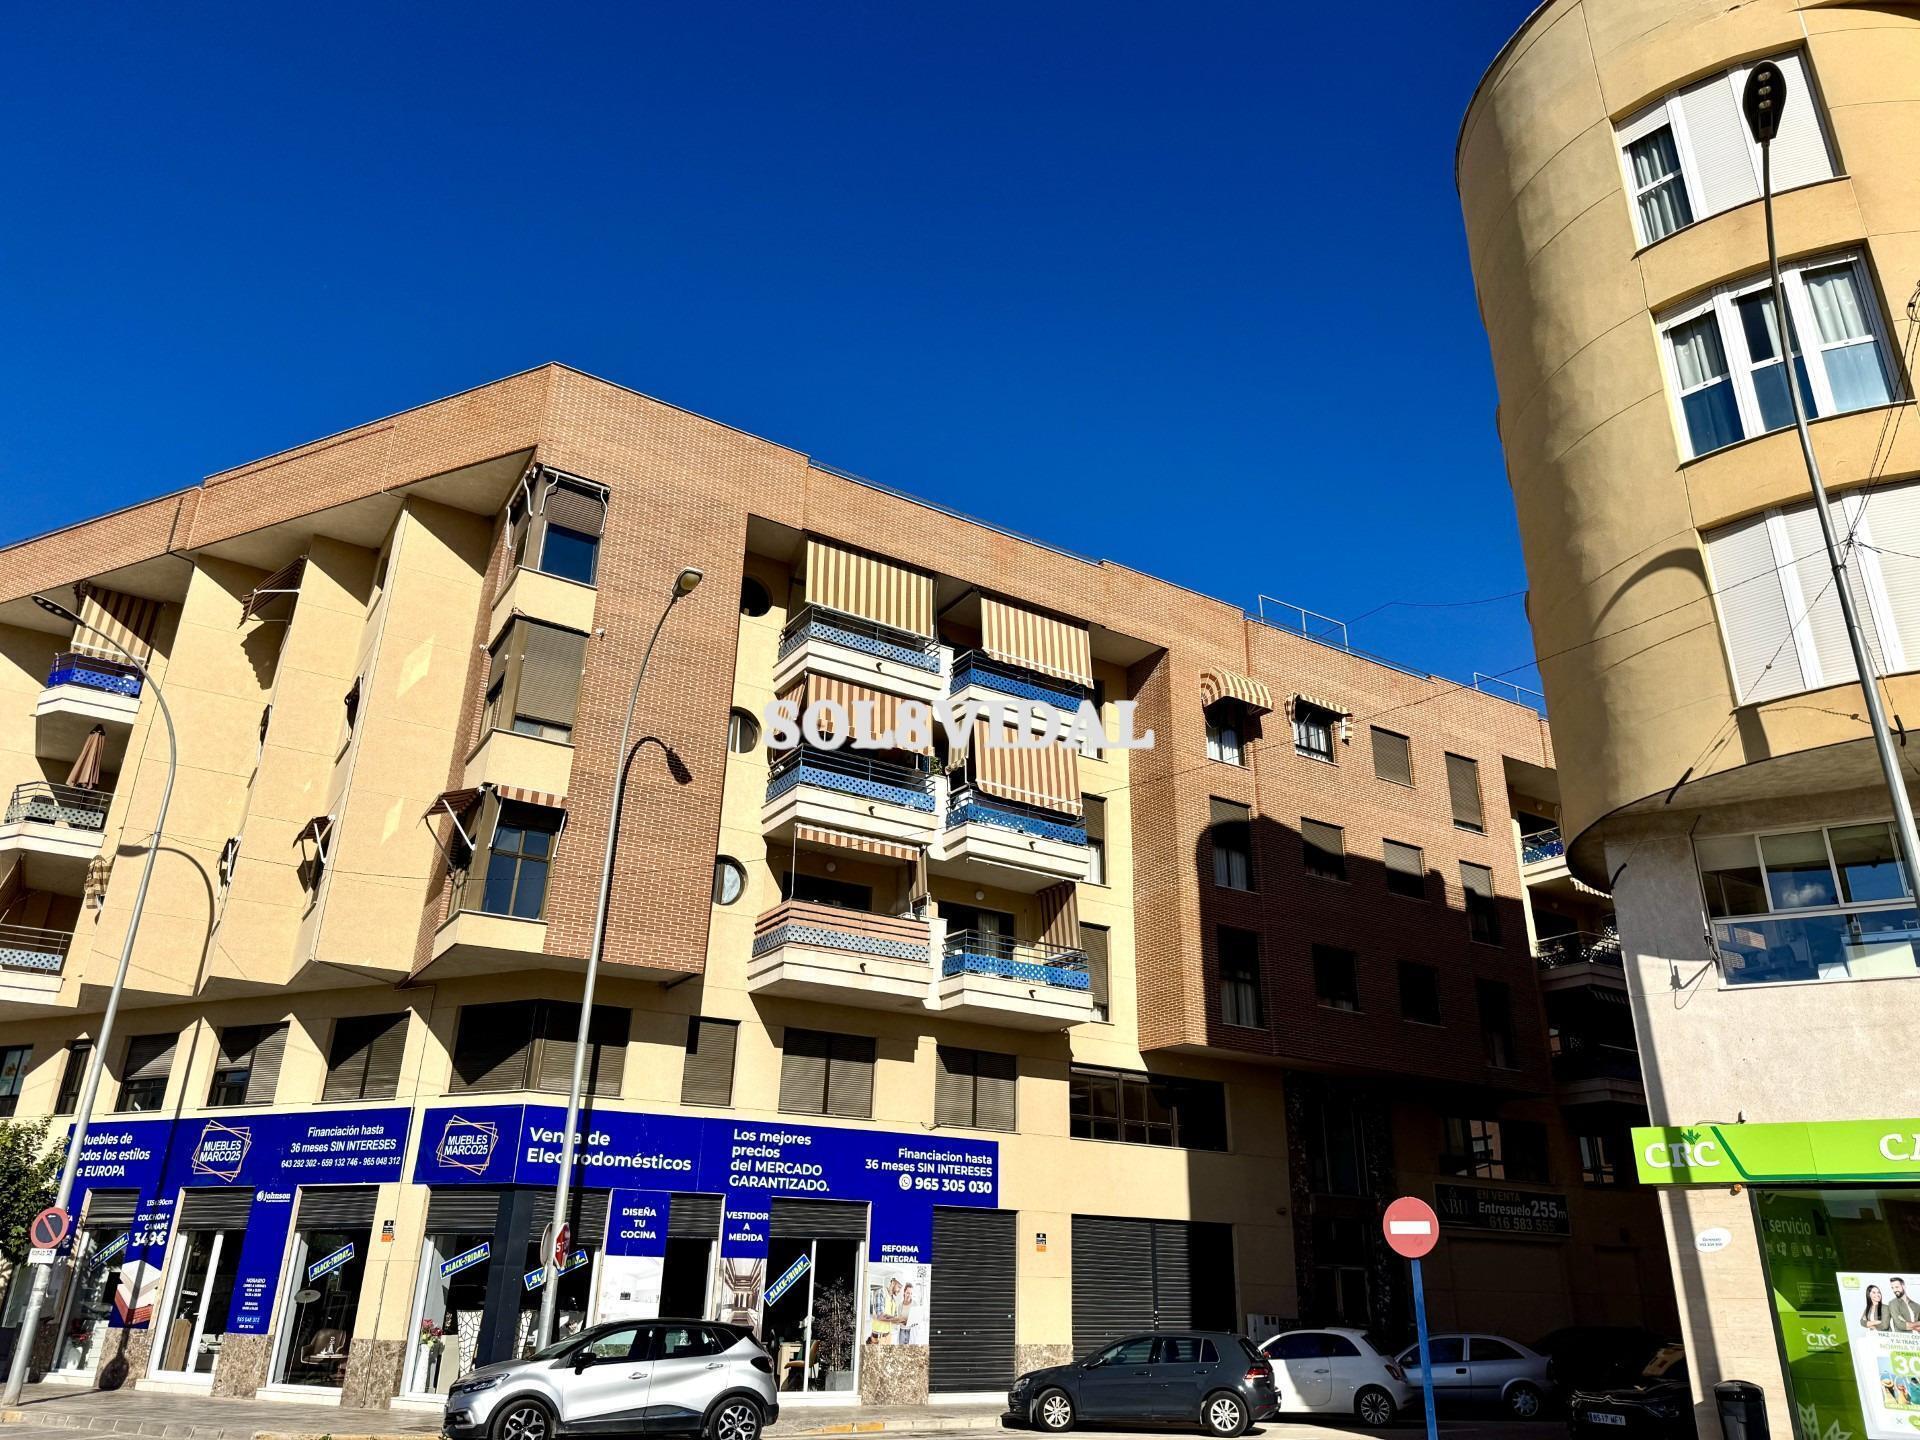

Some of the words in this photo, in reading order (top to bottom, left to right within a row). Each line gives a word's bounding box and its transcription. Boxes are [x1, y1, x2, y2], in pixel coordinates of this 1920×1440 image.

[308, 1125, 359, 1137] Financiación
[361, 1124, 384, 1135] hasta
[529, 1127, 582, 1144] Vena
[588, 1131, 611, 1146] de
[733, 1128, 756, 1141] Los
[759, 1130, 812, 1146] mejores
[120, 1132, 133, 1144] de
[447, 1134, 488, 1146] MUEBLES
[203, 1140, 241, 1152] MUEBLES
[290, 1142, 301, 1153] 36
[302, 1143, 328, 1153] meses
[330, 1140, 346, 1152] SIN
[346, 1139, 397, 1151] INTERESES
[444, 1145, 489, 1155] MARCO25
[731, 1144, 780, 1158] precios
[79, 1149, 102, 1162] odos
[103, 1148, 117, 1161] los
[119, 1147, 151, 1160] estilos
[199, 1151, 241, 1163] MARCO25
[527, 1147, 692, 1171] Elecrodomésticos
[898, 1147, 963, 1162] Financiacion
[965, 1152, 993, 1165] hasta
[1645, 1141, 1720, 1168] CRC
[334, 1158, 346, 1167] 132
[346, 1158, 358, 1166] 746
[363, 1157, 375, 1166] 965
[388, 1156, 401, 1165] 312
[730, 1158, 752, 1172] del
[755, 1160, 823, 1176] MERCADO
[865, 1159, 879, 1170] 36
[881, 1161, 915, 1172] meses
[917, 1162, 935, 1173] SIN
[937, 1164, 993, 1177] INTERESES
[76, 1167, 83, 1177] e
[84, 1165, 125, 1177] EUROPA
[729, 1174, 830, 1192] GARANTIZADO.
[915, 1177, 939, 1191] 965
[942, 1178, 966, 1192] 305
[968, 1180, 993, 1194] 030
[622, 1206, 657, 1217] DISEÑA
[726, 1211, 769, 1220] VESTIDOR
[1478, 1201, 1531, 1217] Entresuelo
[1530, 1200, 1558, 1218] 255
[633, 1219, 646, 1228] TU
[743, 1223, 751, 1231] A
[132, 1231, 167, 1247] 349€
[620, 1230, 657, 1239] COCINA
[728, 1233, 764, 1242] MEDIDA
[881, 1244, 919, 1253] REFORMA
[881, 1254, 919, 1263] INTEGRAL
[1806, 1334, 1840, 1347] CRC
